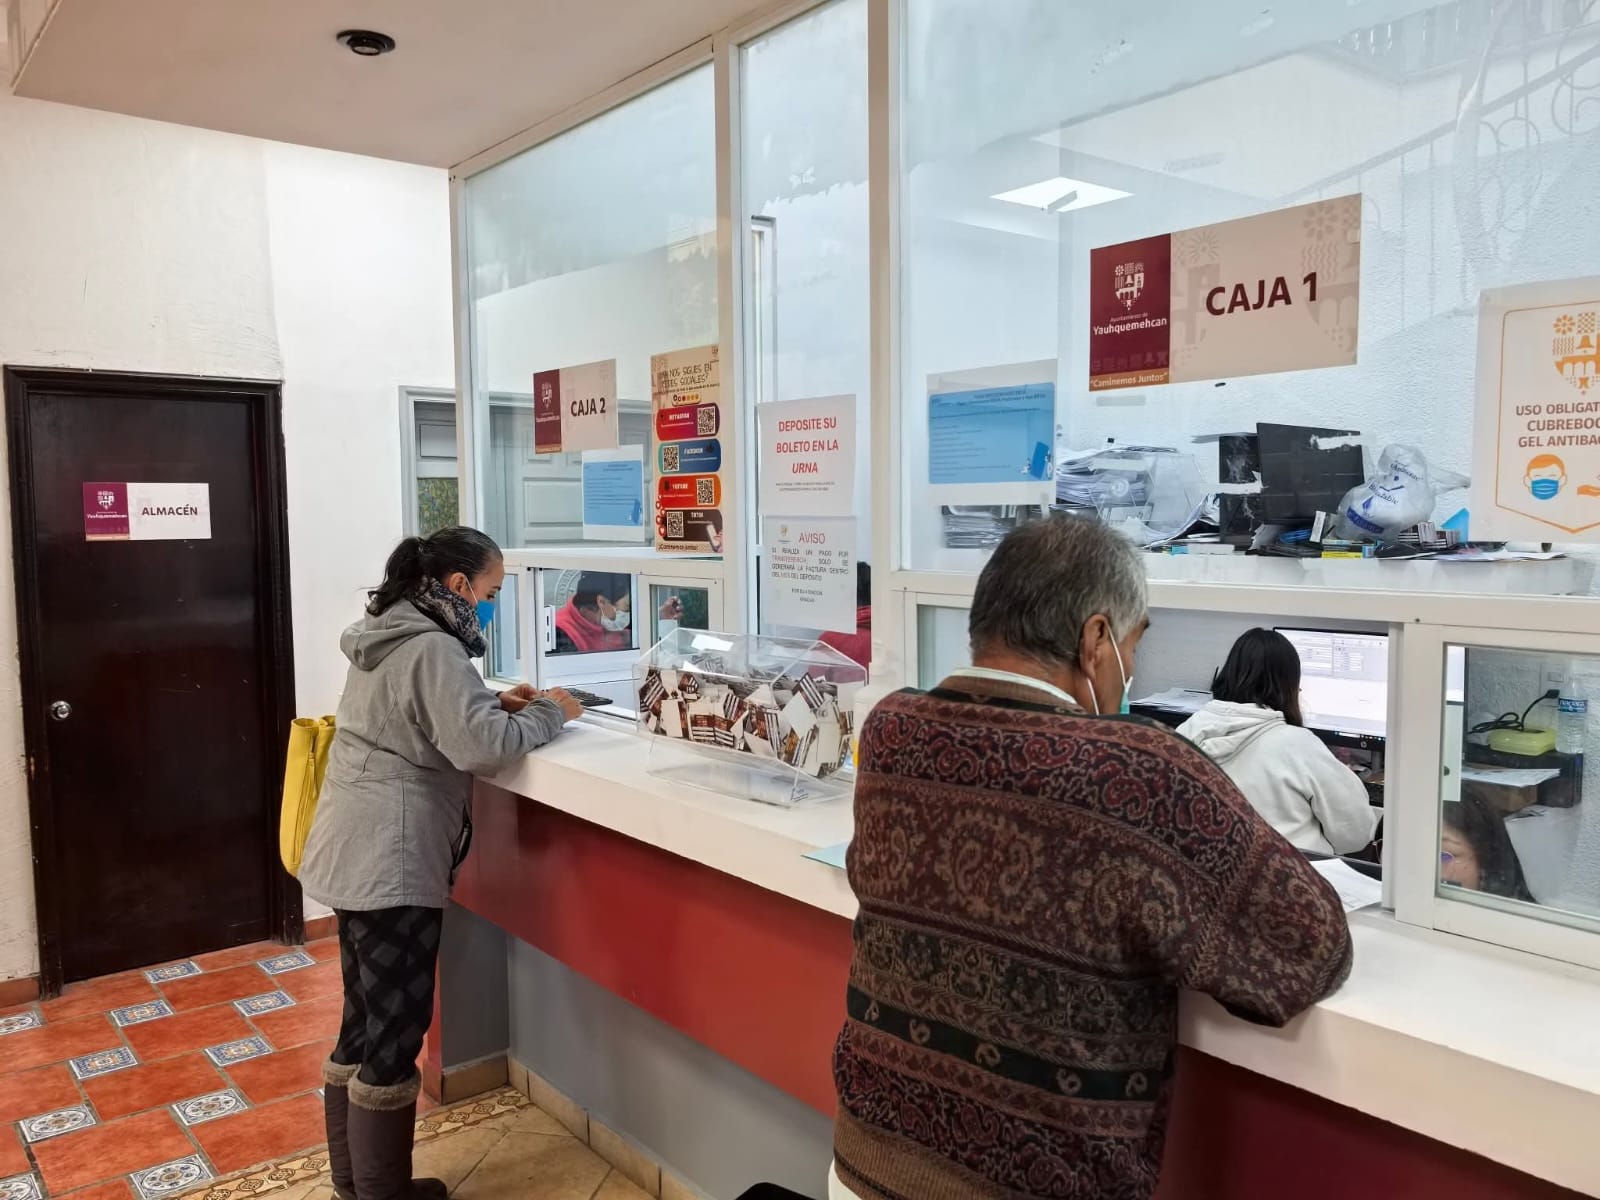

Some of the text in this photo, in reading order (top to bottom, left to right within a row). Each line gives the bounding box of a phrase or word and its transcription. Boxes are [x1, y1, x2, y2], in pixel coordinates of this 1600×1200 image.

[1206, 271, 1318, 316] CAJA 1
[1093, 317, 1168, 335] Yauhquemehcan
[570, 397, 606, 417] CAJA 2
[1515, 404, 1542, 416] USO
[778, 416, 837, 433] DEPOSITE SU
[776, 439, 839, 454] BOLETO EN LA
[1518, 435, 1544, 448] GEL
[792, 461, 818, 474] URNA
[141, 504, 198, 516] ALMACÉN
[798, 531, 826, 545] AVISO
